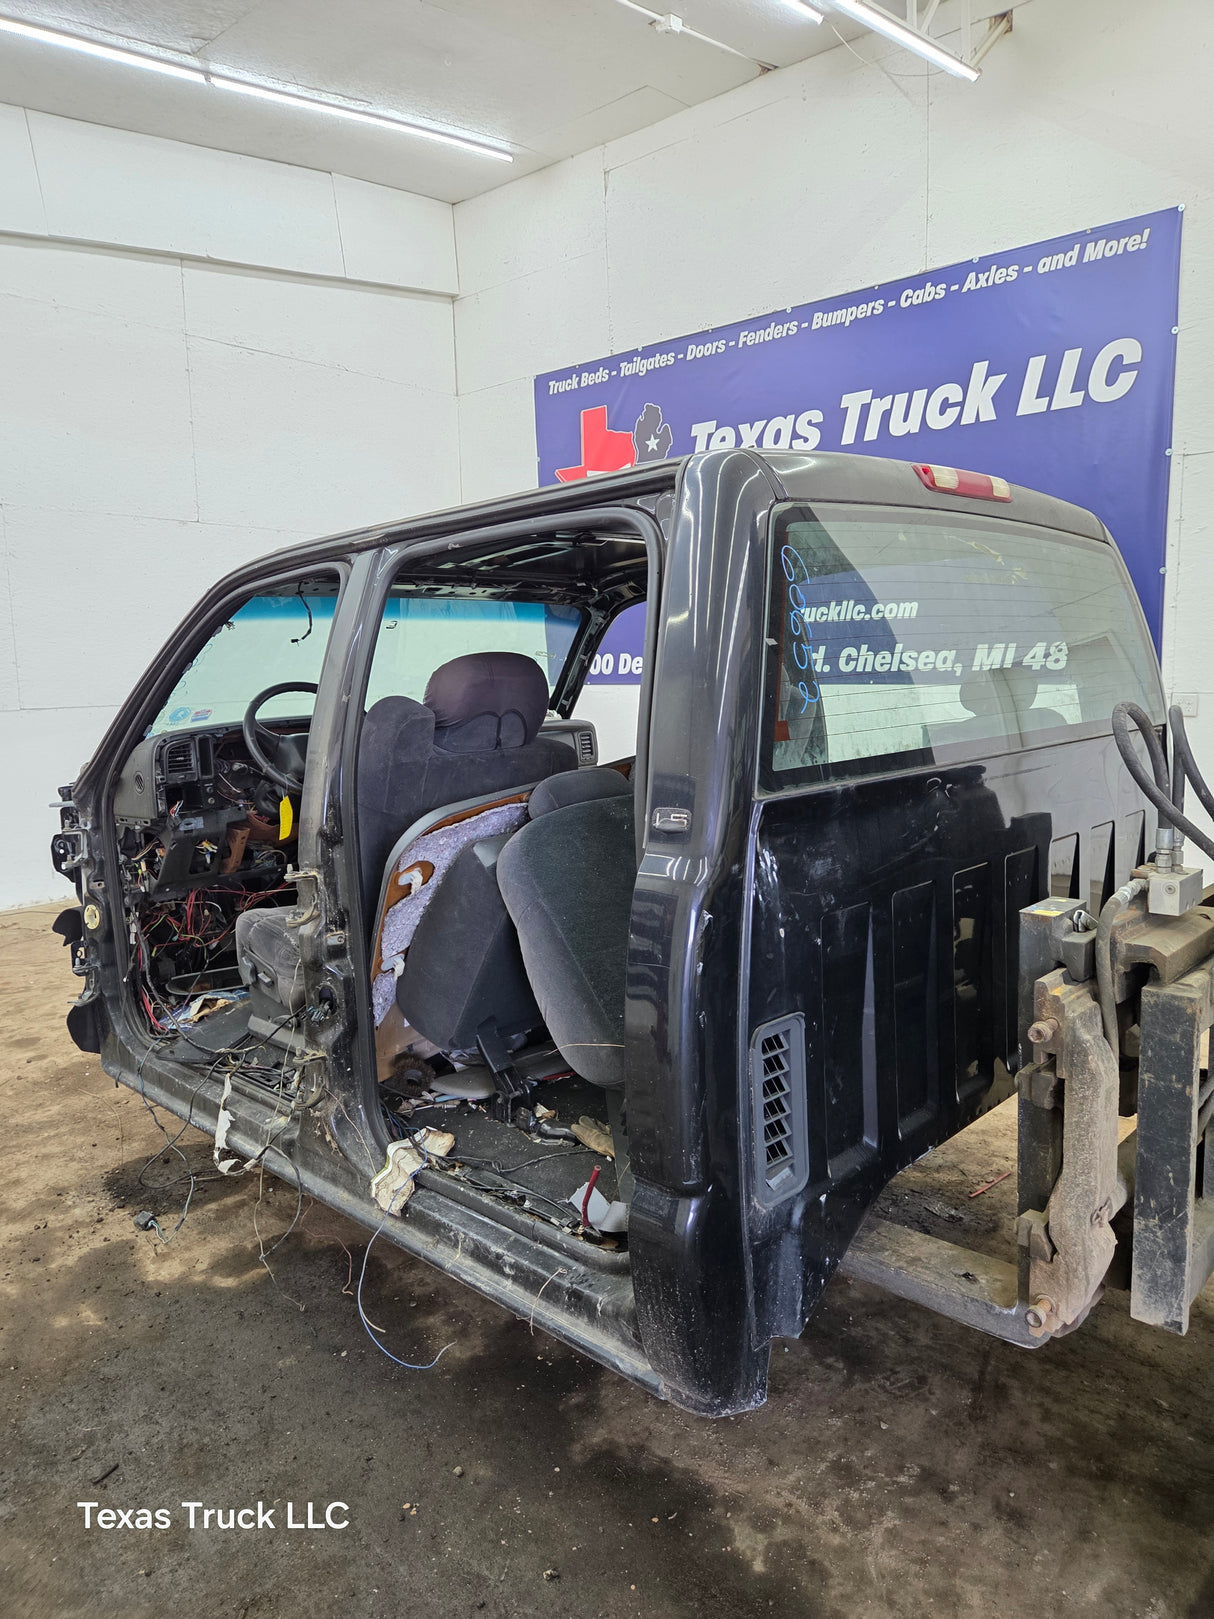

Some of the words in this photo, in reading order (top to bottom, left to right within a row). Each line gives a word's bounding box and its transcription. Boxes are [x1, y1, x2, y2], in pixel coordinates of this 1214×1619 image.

[549, 377, 579, 395] Truck
[581, 367, 609, 387] Beds
[620, 351, 675, 378] Tailgates
[686, 339, 726, 360] Doors
[738, 320, 798, 348] Fenders
[811, 299, 884, 330] Bumpers
[900, 283, 946, 308] Cabs
[962, 265, 1018, 293] Axles
[1037, 245, 1079, 274] and
[1083, 228, 1151, 263] More!
[690, 409, 824, 450] Texas
[840, 360, 1007, 445] Truck
[1016, 338, 1143, 416] LLC
[801, 600, 918, 622] uckllc.com
[838, 643, 962, 676] Chelsea,
[971, 642, 1016, 671] MI
